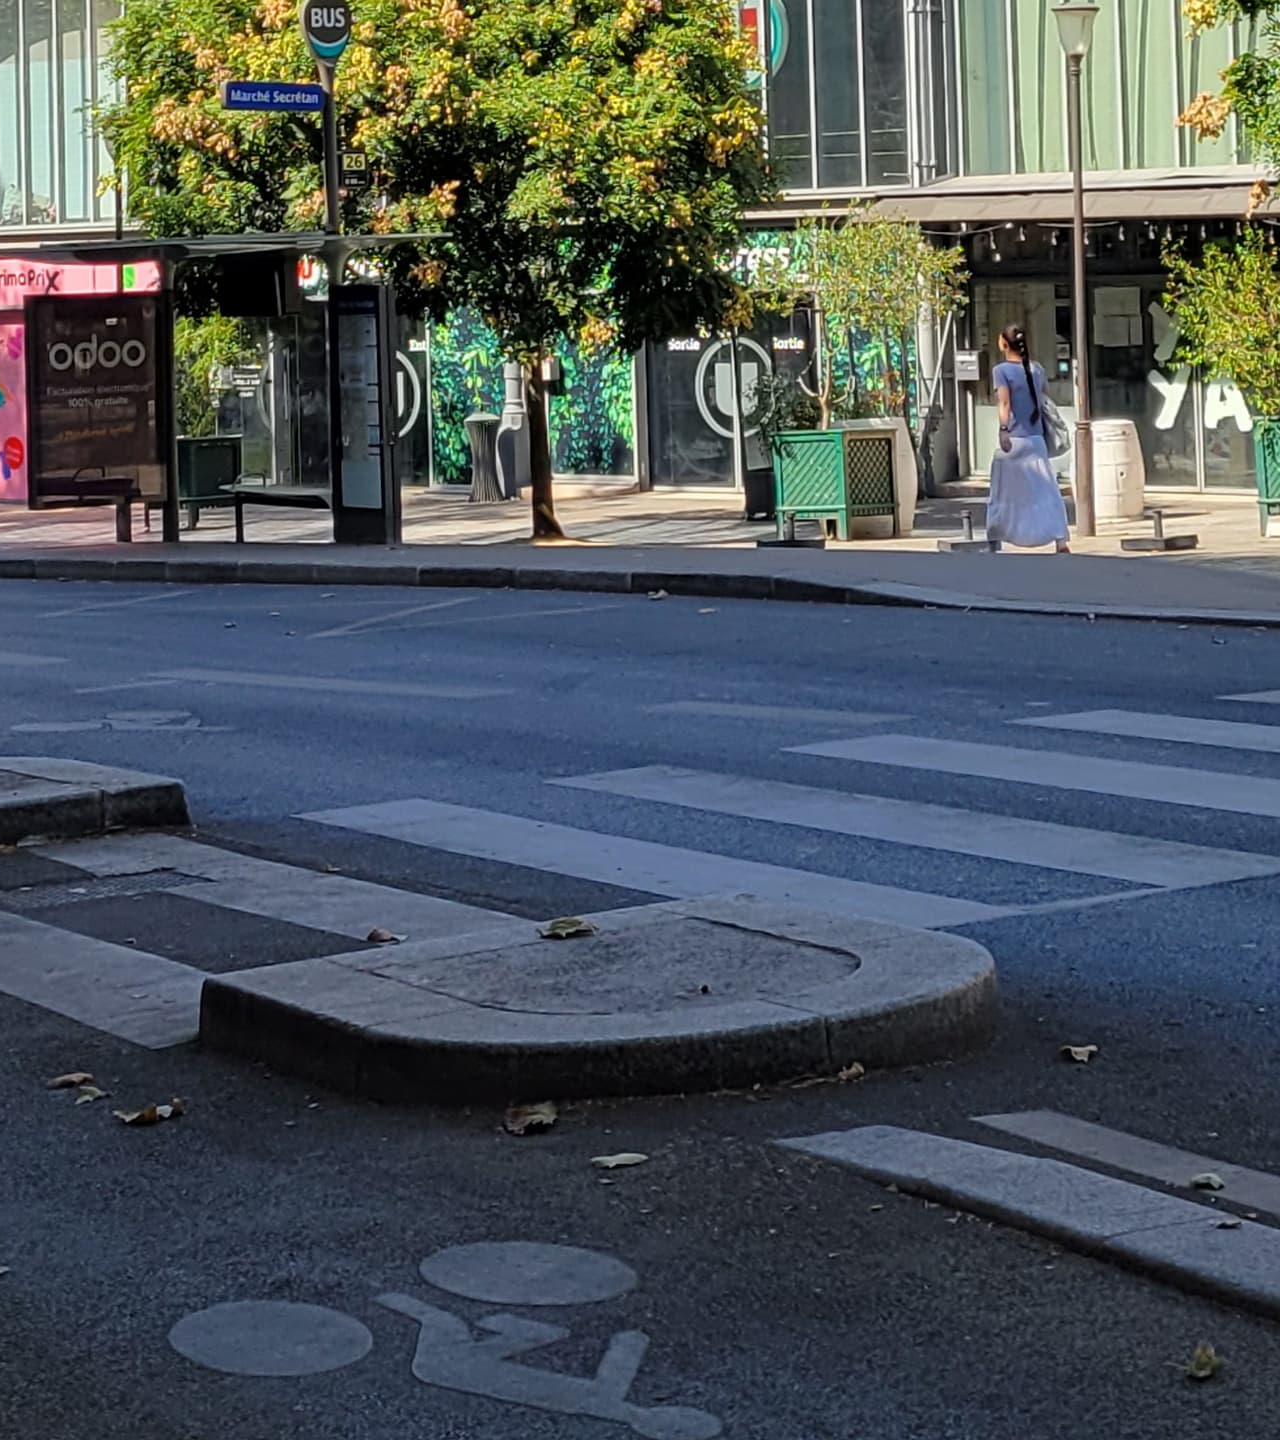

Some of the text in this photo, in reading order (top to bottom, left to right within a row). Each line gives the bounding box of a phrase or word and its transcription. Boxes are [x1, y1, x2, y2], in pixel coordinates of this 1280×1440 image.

[311, 7, 345, 28] BUS
[231, 89, 319, 104] Marché Secrétan
[345, 155, 363, 169] 26
[48, 332, 146, 371] odoo
